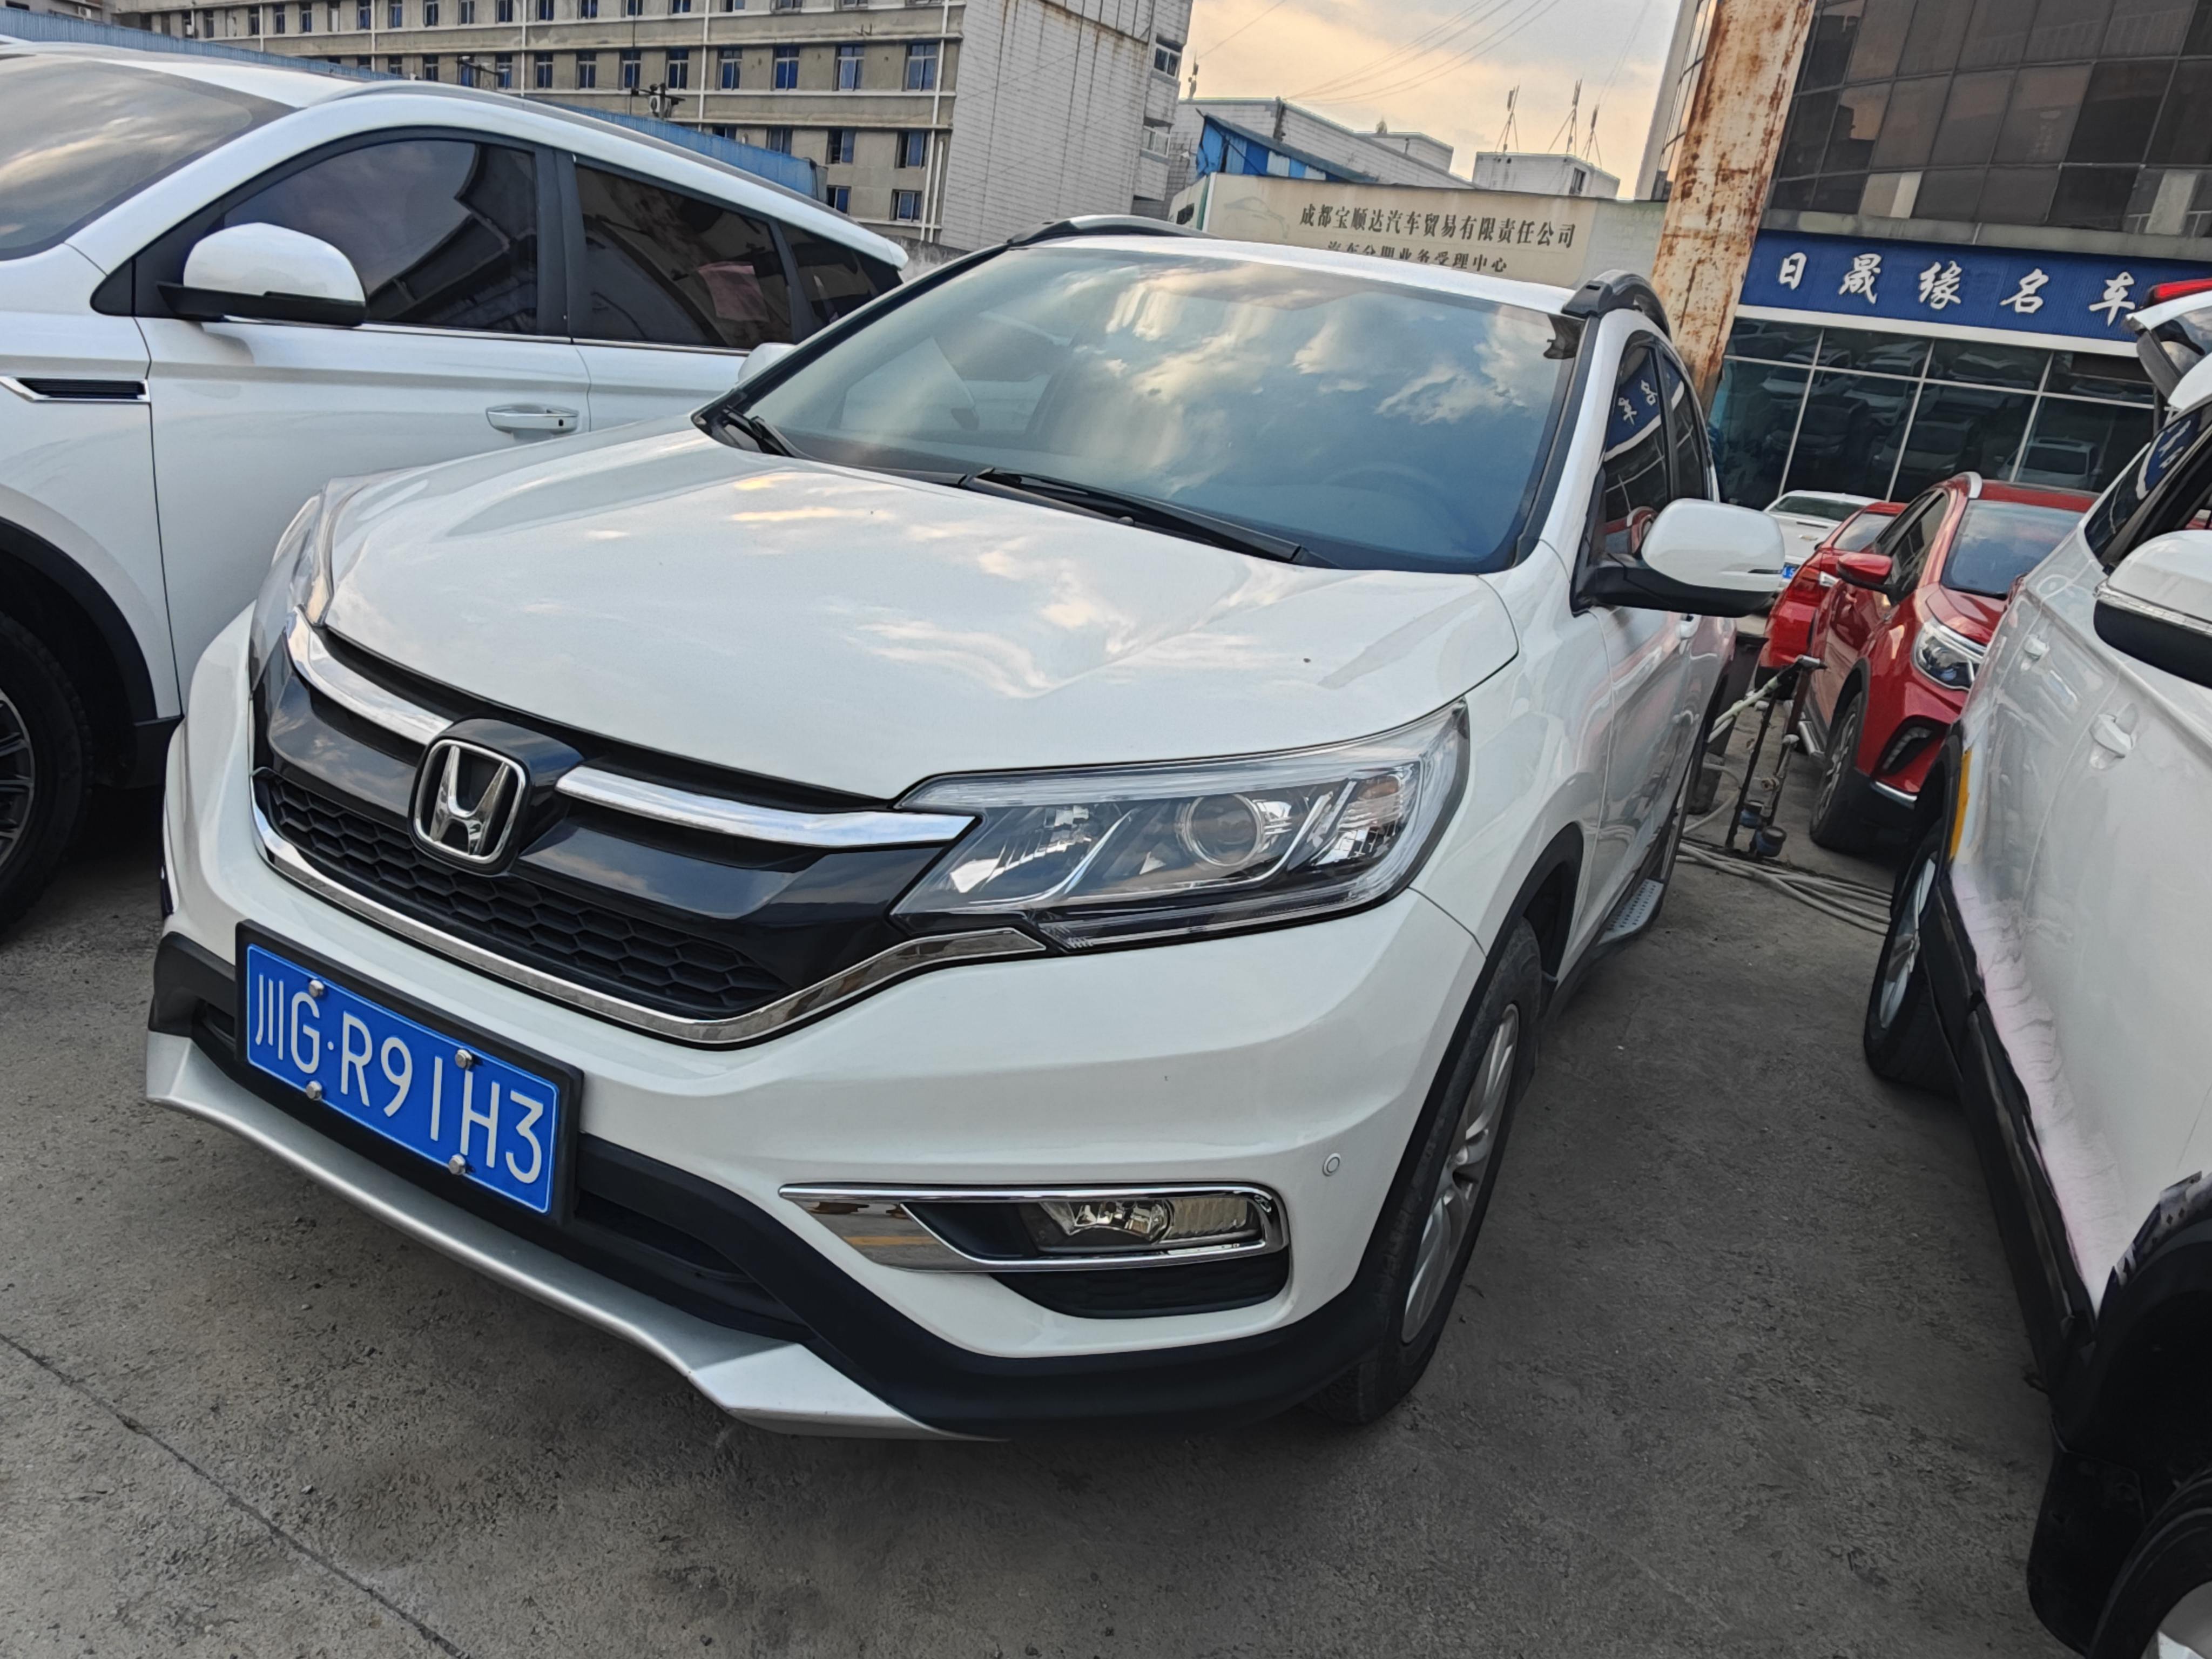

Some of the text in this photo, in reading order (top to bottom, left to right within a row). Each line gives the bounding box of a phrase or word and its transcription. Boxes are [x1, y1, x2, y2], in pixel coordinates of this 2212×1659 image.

[1300, 203, 1576, 248] 成都宝顺达汽车贸易有限责任公司
[1778, 252, 2136, 326] 日晟缘名车
